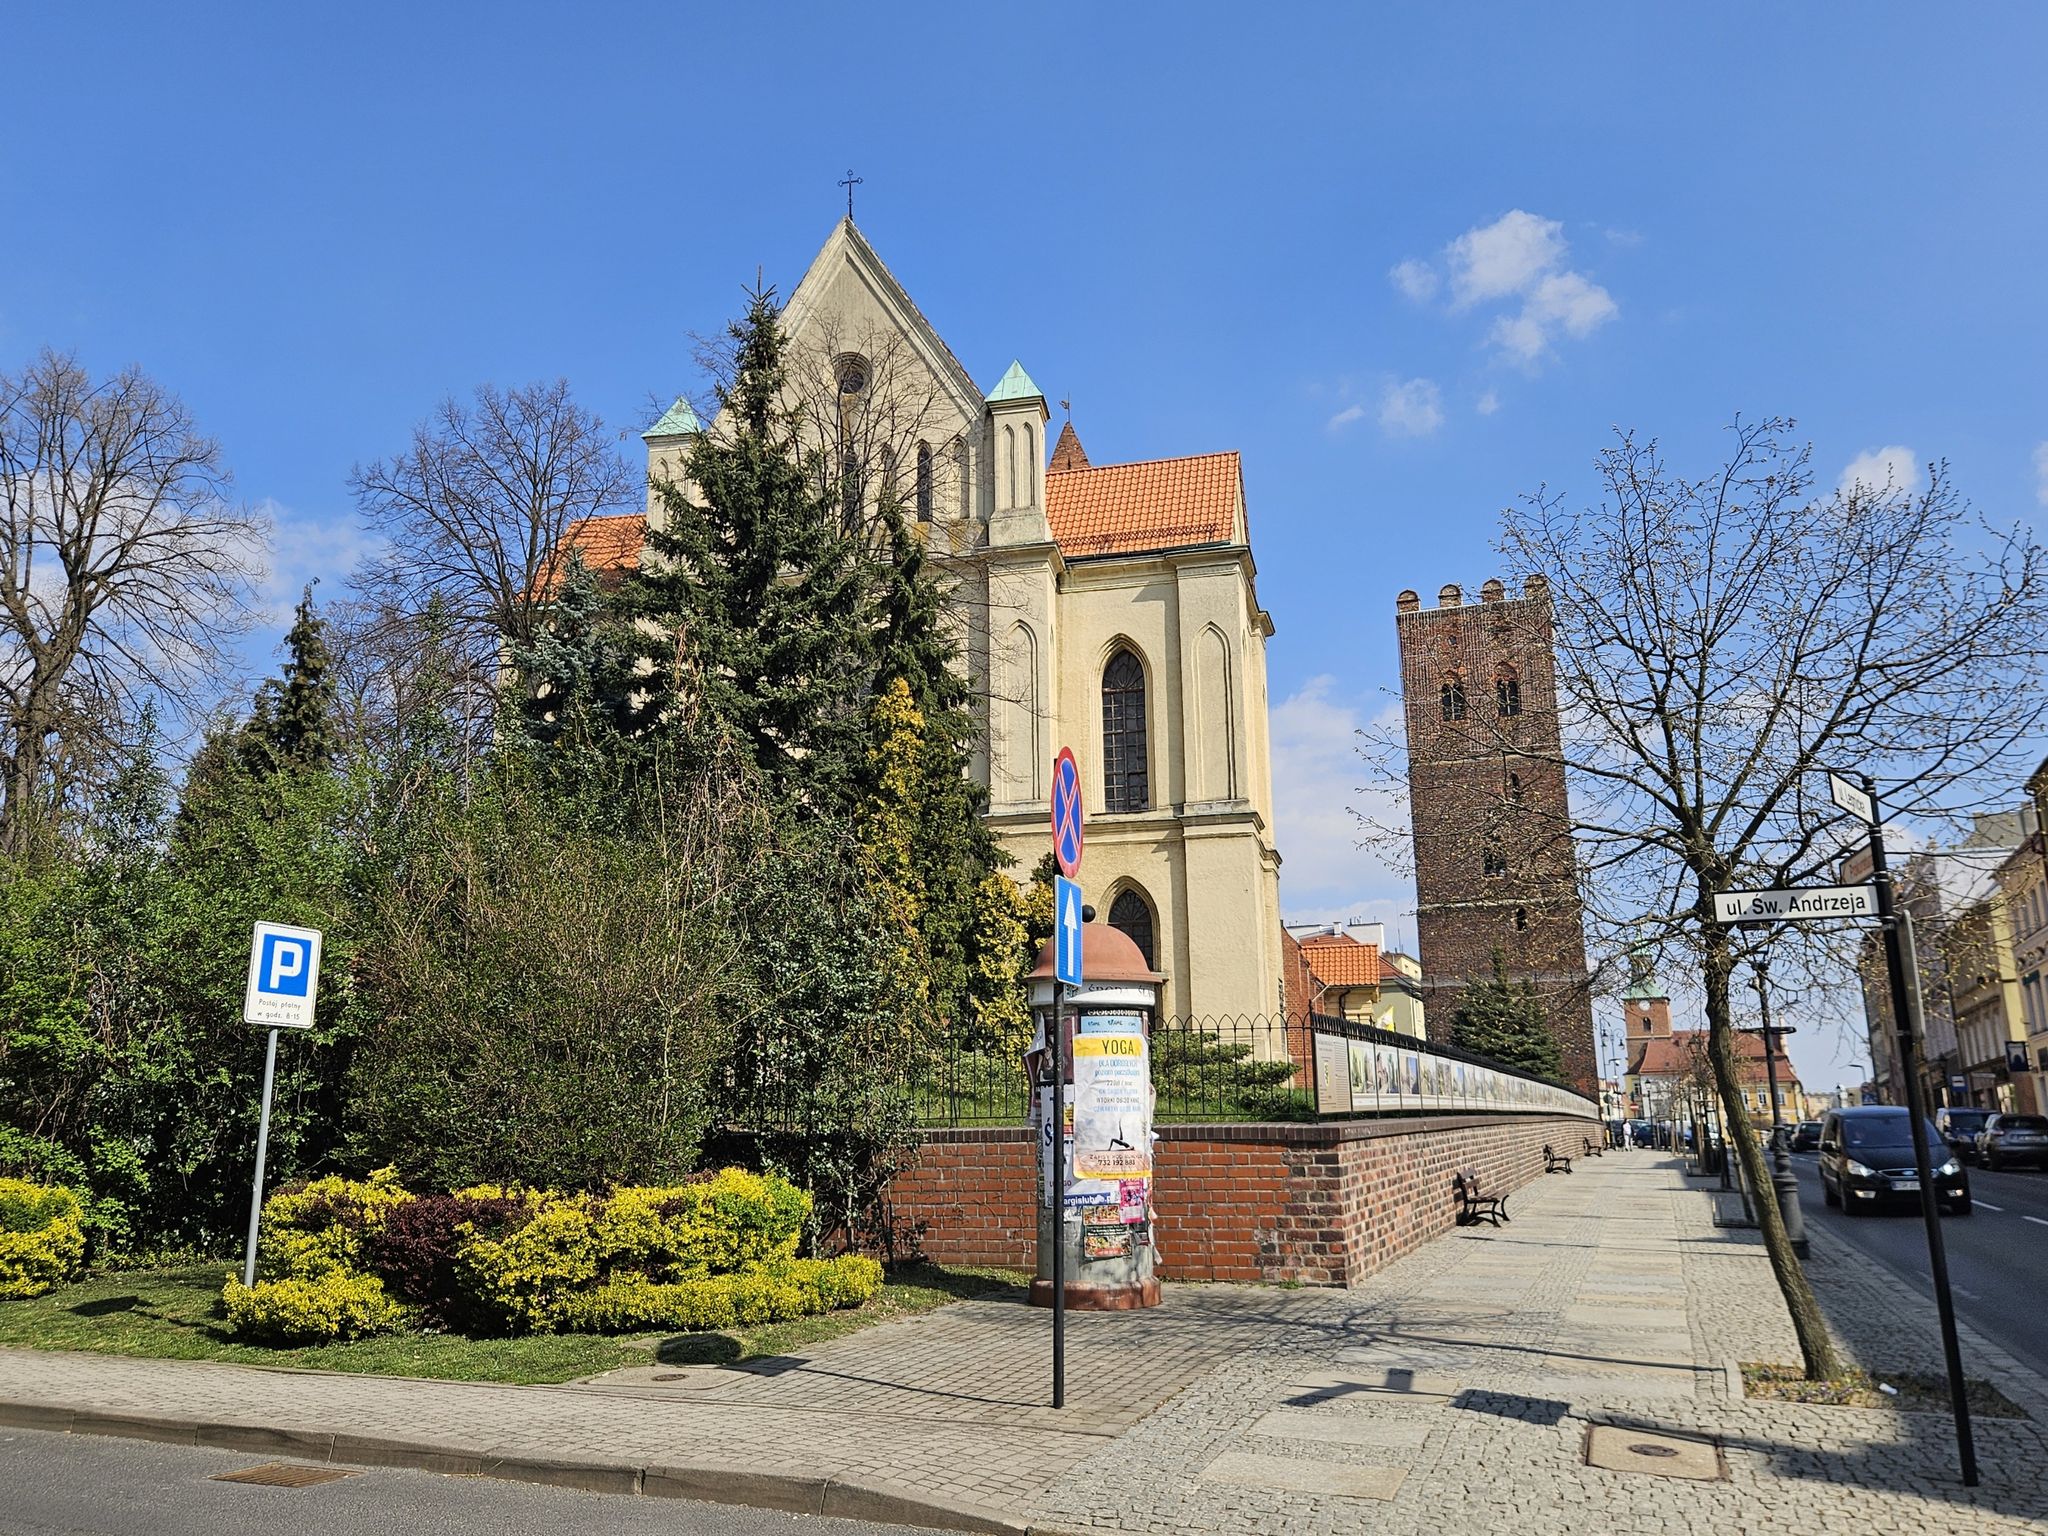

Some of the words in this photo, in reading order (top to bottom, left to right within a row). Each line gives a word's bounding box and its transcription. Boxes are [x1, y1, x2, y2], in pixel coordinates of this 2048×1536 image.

[1726, 899, 1747, 916] ul.
[1752, 893, 1783, 914] Św.
[1788, 893, 1866, 914] Andrzeja
[270, 940, 303, 989] P
[266, 1011, 282, 1019] godz.
[1102, 1039, 1134, 1055] YOGA
